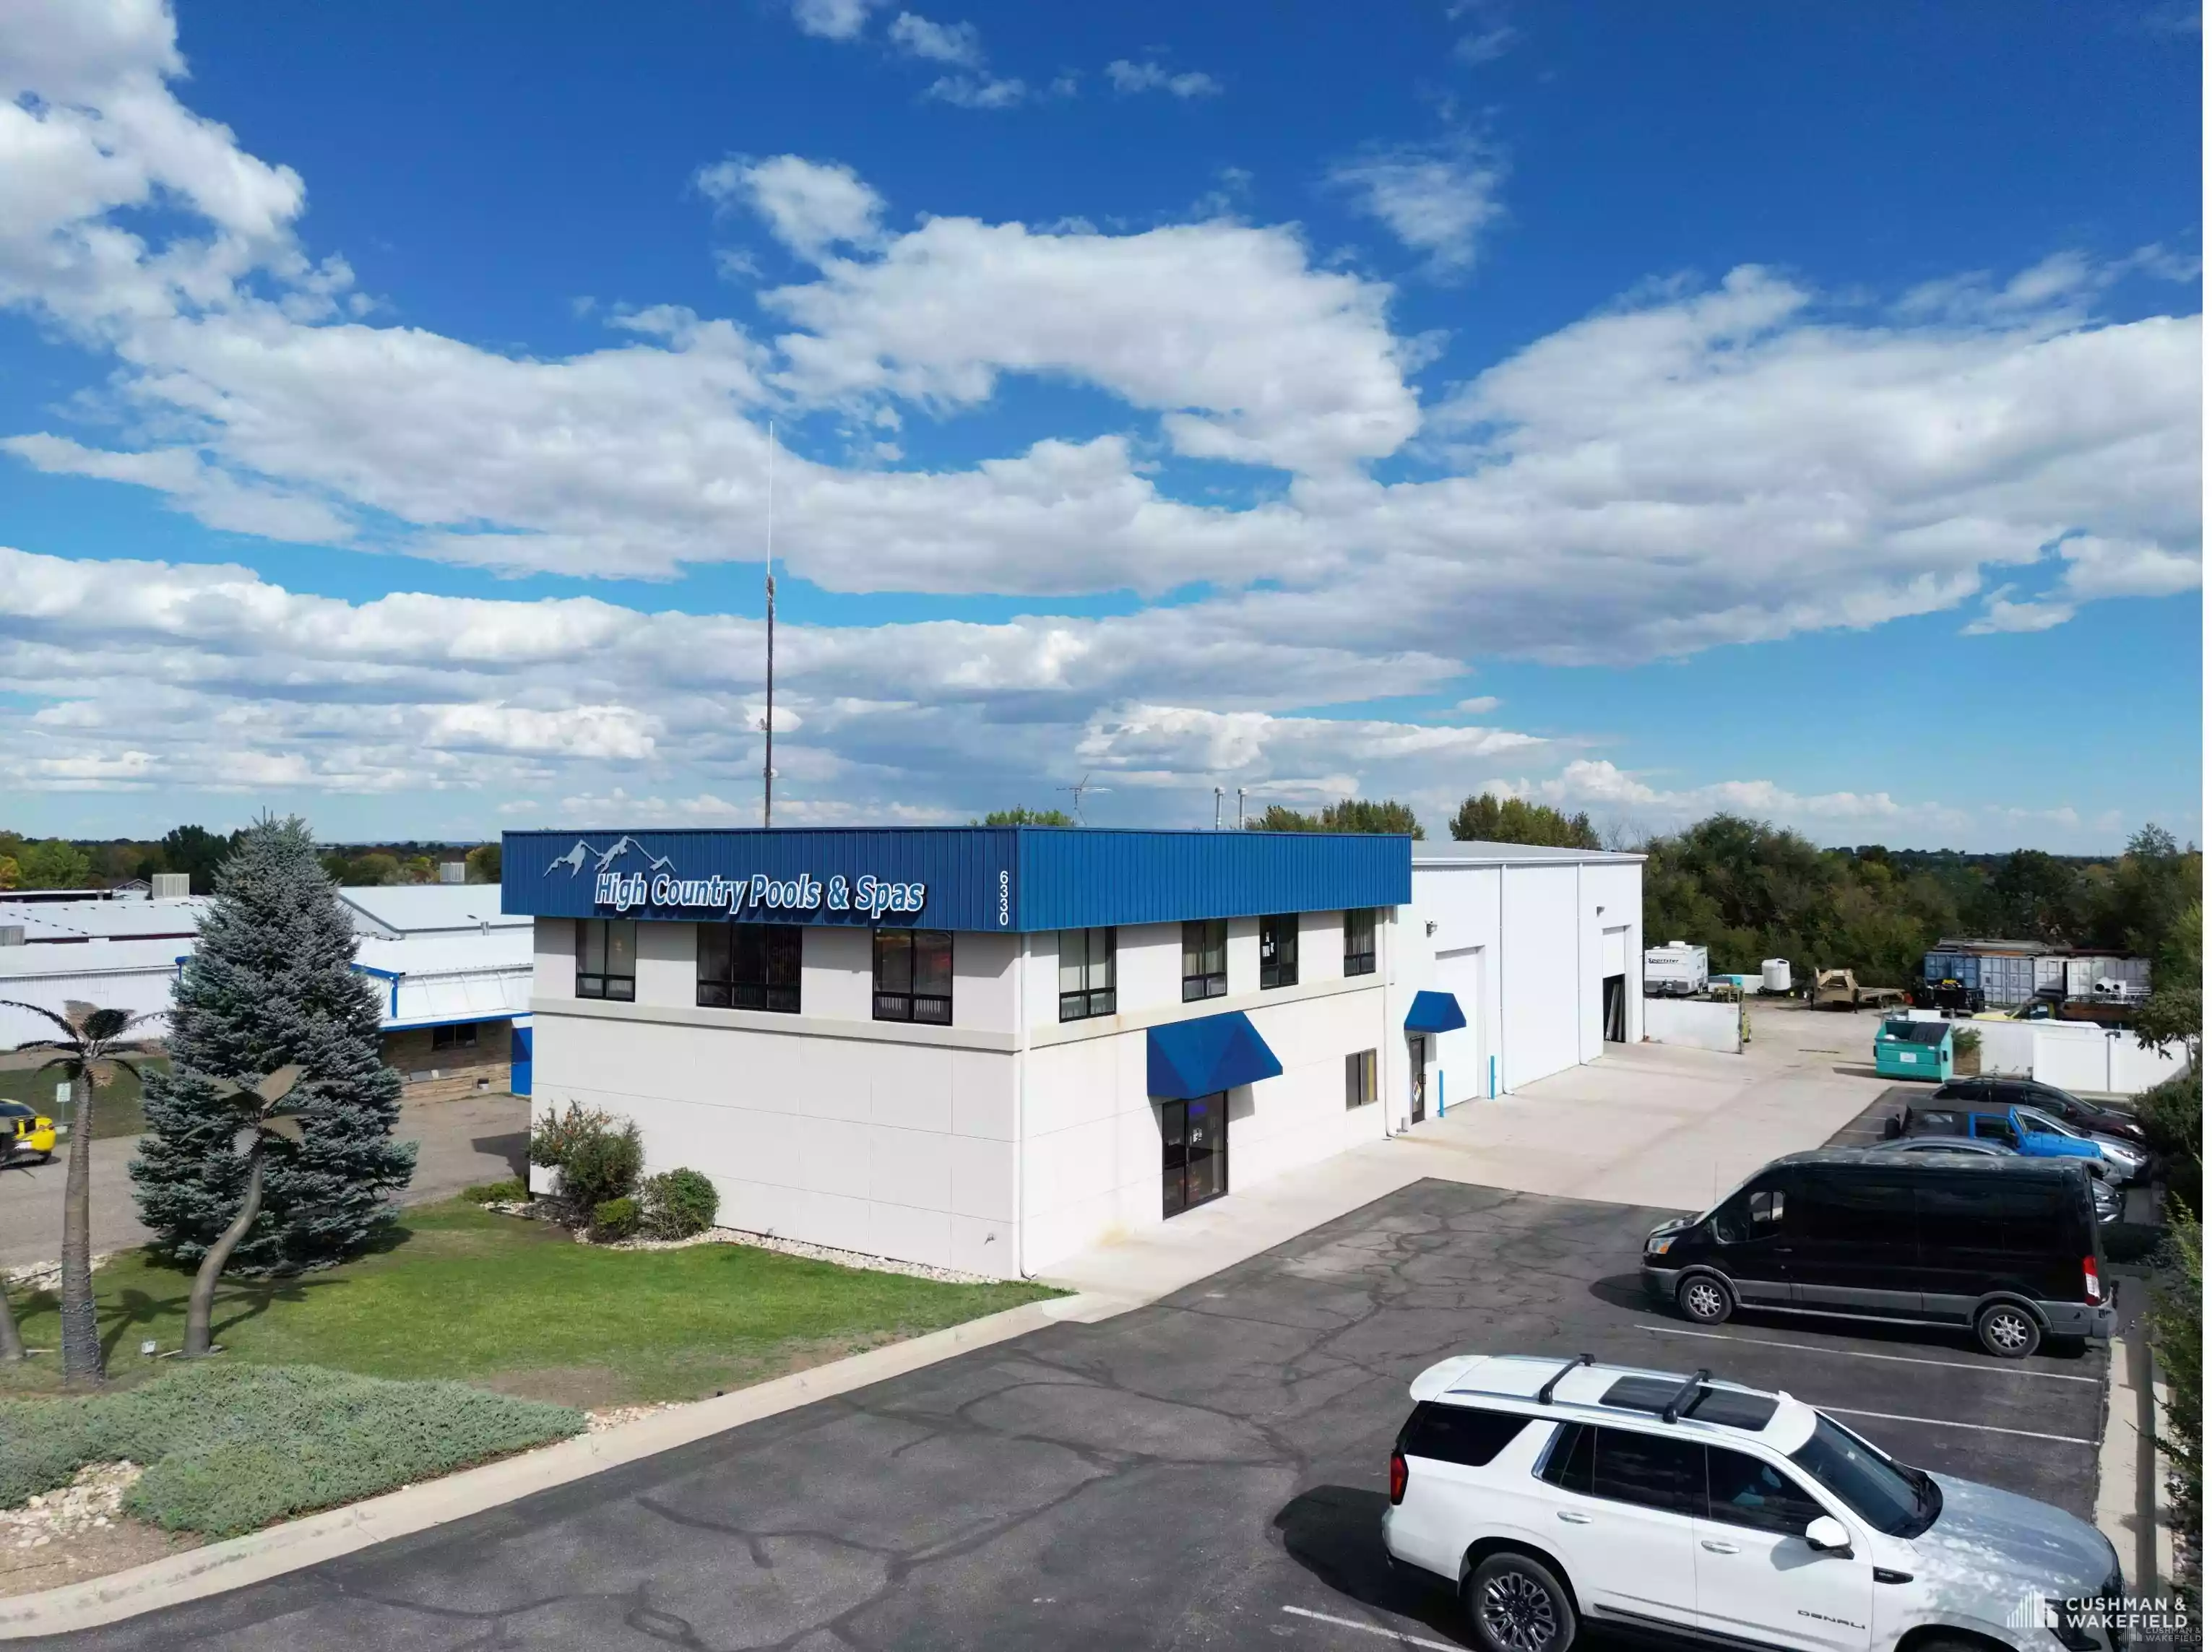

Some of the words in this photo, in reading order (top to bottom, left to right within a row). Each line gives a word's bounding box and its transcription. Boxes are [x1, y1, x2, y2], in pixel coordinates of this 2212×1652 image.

[595, 873, 647, 912] High
[652, 873, 748, 914] Country
[749, 873, 821, 909] Pools
[828, 875, 850, 910] &
[855, 875, 925, 919] Spas
[999, 870, 1008, 925] 6330
[1797, 1609, 1865, 1629] DENALI
